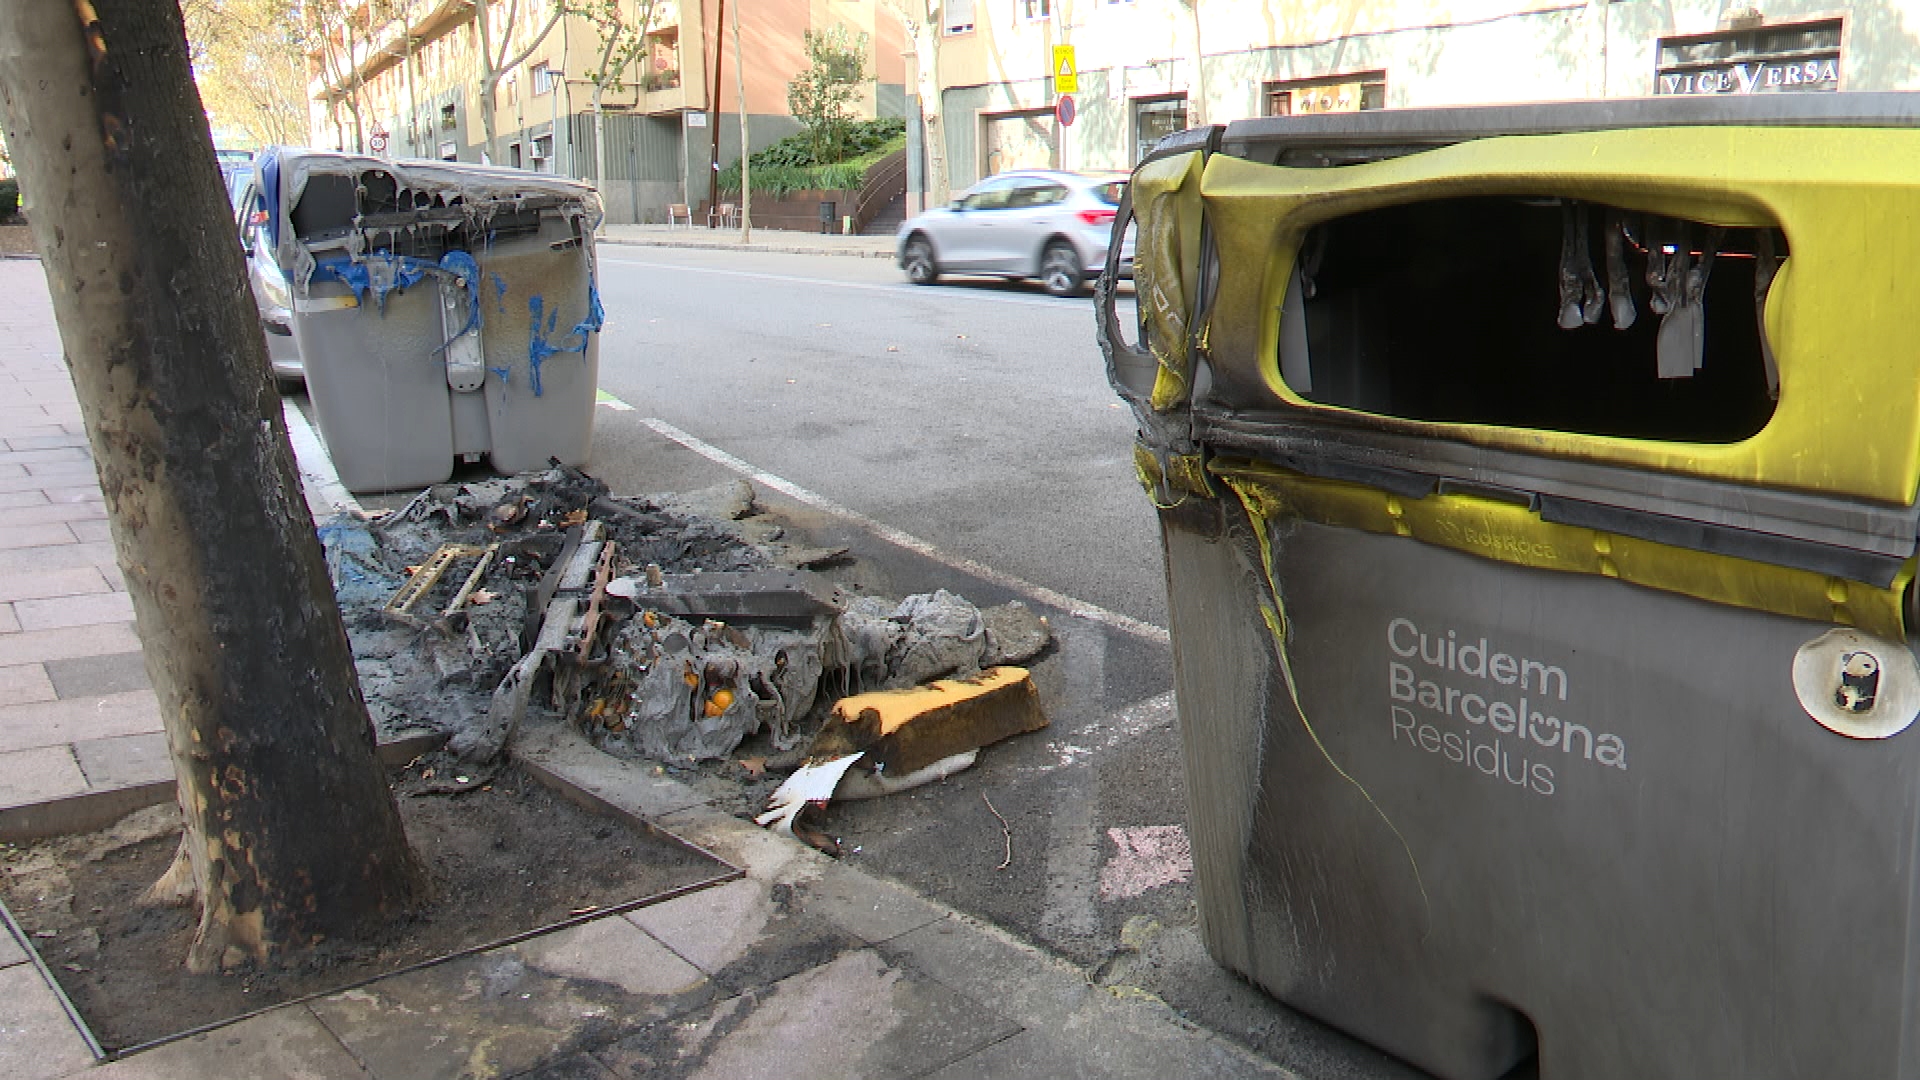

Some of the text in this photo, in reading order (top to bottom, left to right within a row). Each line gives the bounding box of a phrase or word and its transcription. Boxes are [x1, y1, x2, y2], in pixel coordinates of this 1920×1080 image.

[1388, 618, 1567, 700] Cuidem
[1389, 662, 1627, 770] Barcelona
[1391, 706, 1555, 795] Residus
